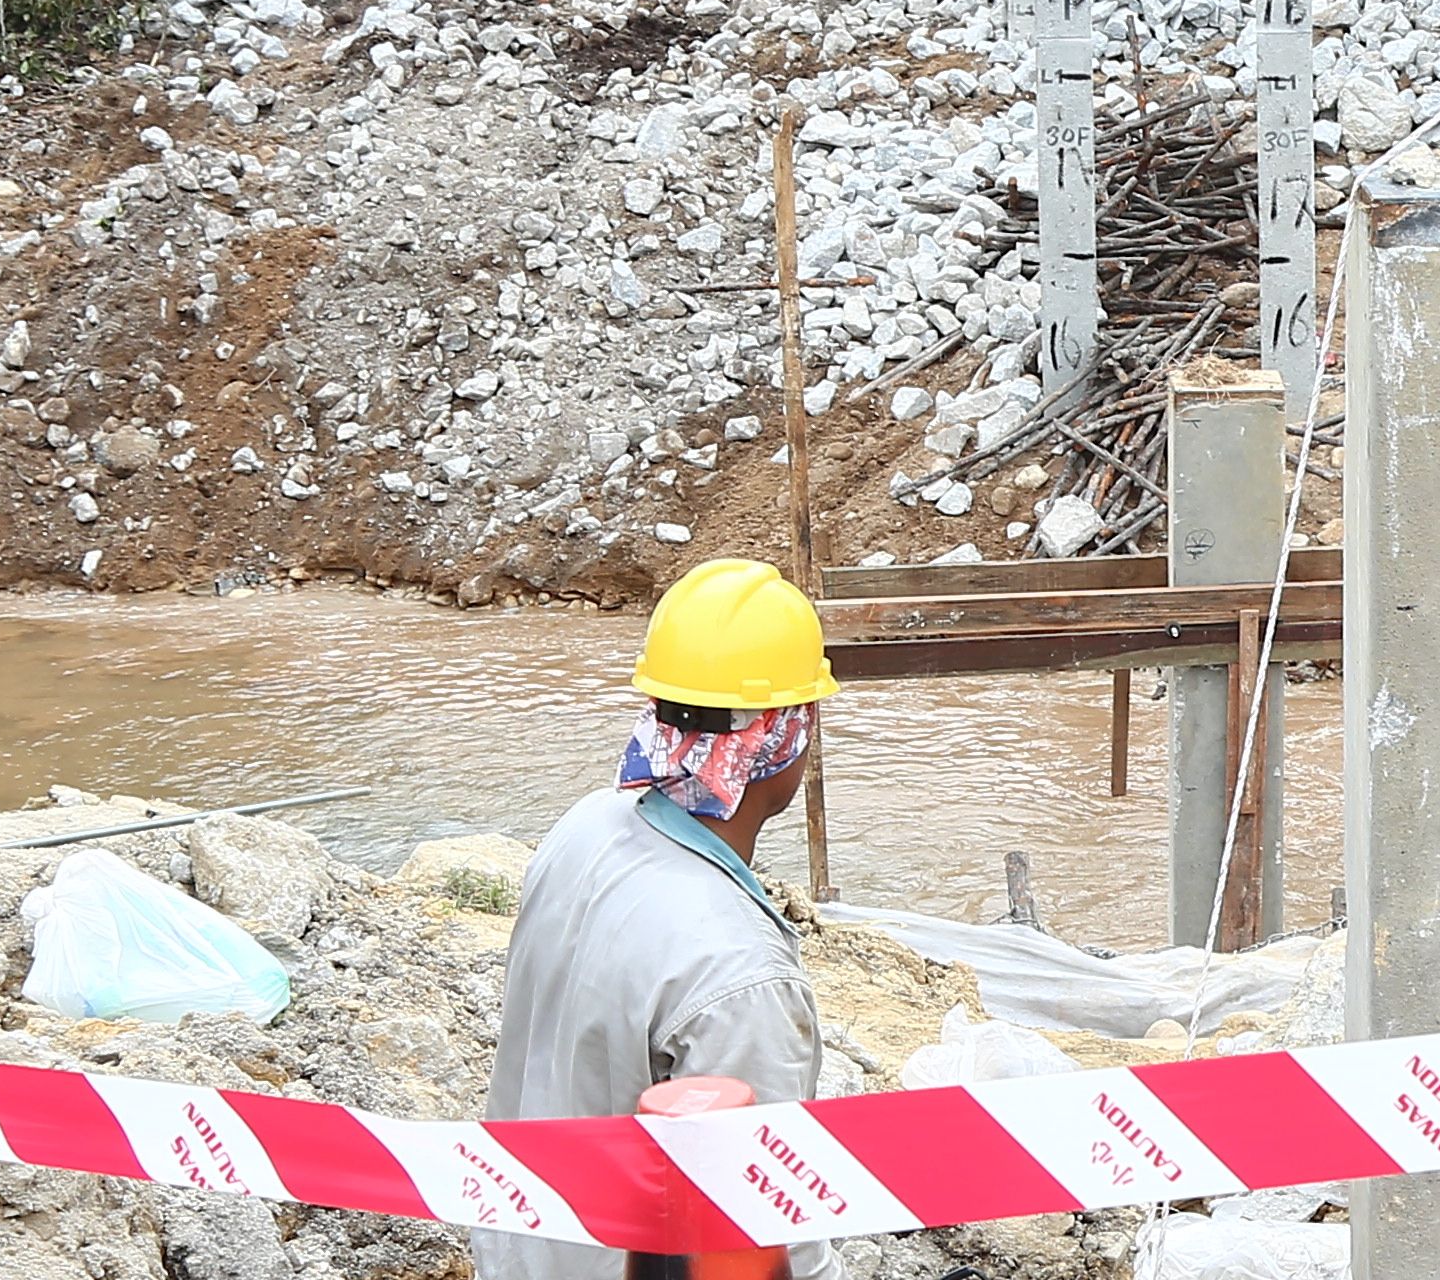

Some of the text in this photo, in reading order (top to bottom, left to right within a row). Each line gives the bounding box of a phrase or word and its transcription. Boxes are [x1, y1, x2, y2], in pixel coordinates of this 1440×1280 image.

[1046, 126, 1091, 146] 30F
[1263, 129, 1308, 151] 30F
[1272, 292, 1309, 352] 16
[1093, 1093, 1182, 1182] CAUTION
[453, 1142, 542, 1229] CAUTION
[743, 1164, 810, 1225] AWAS
[754, 1124, 847, 1215] CAUTION
